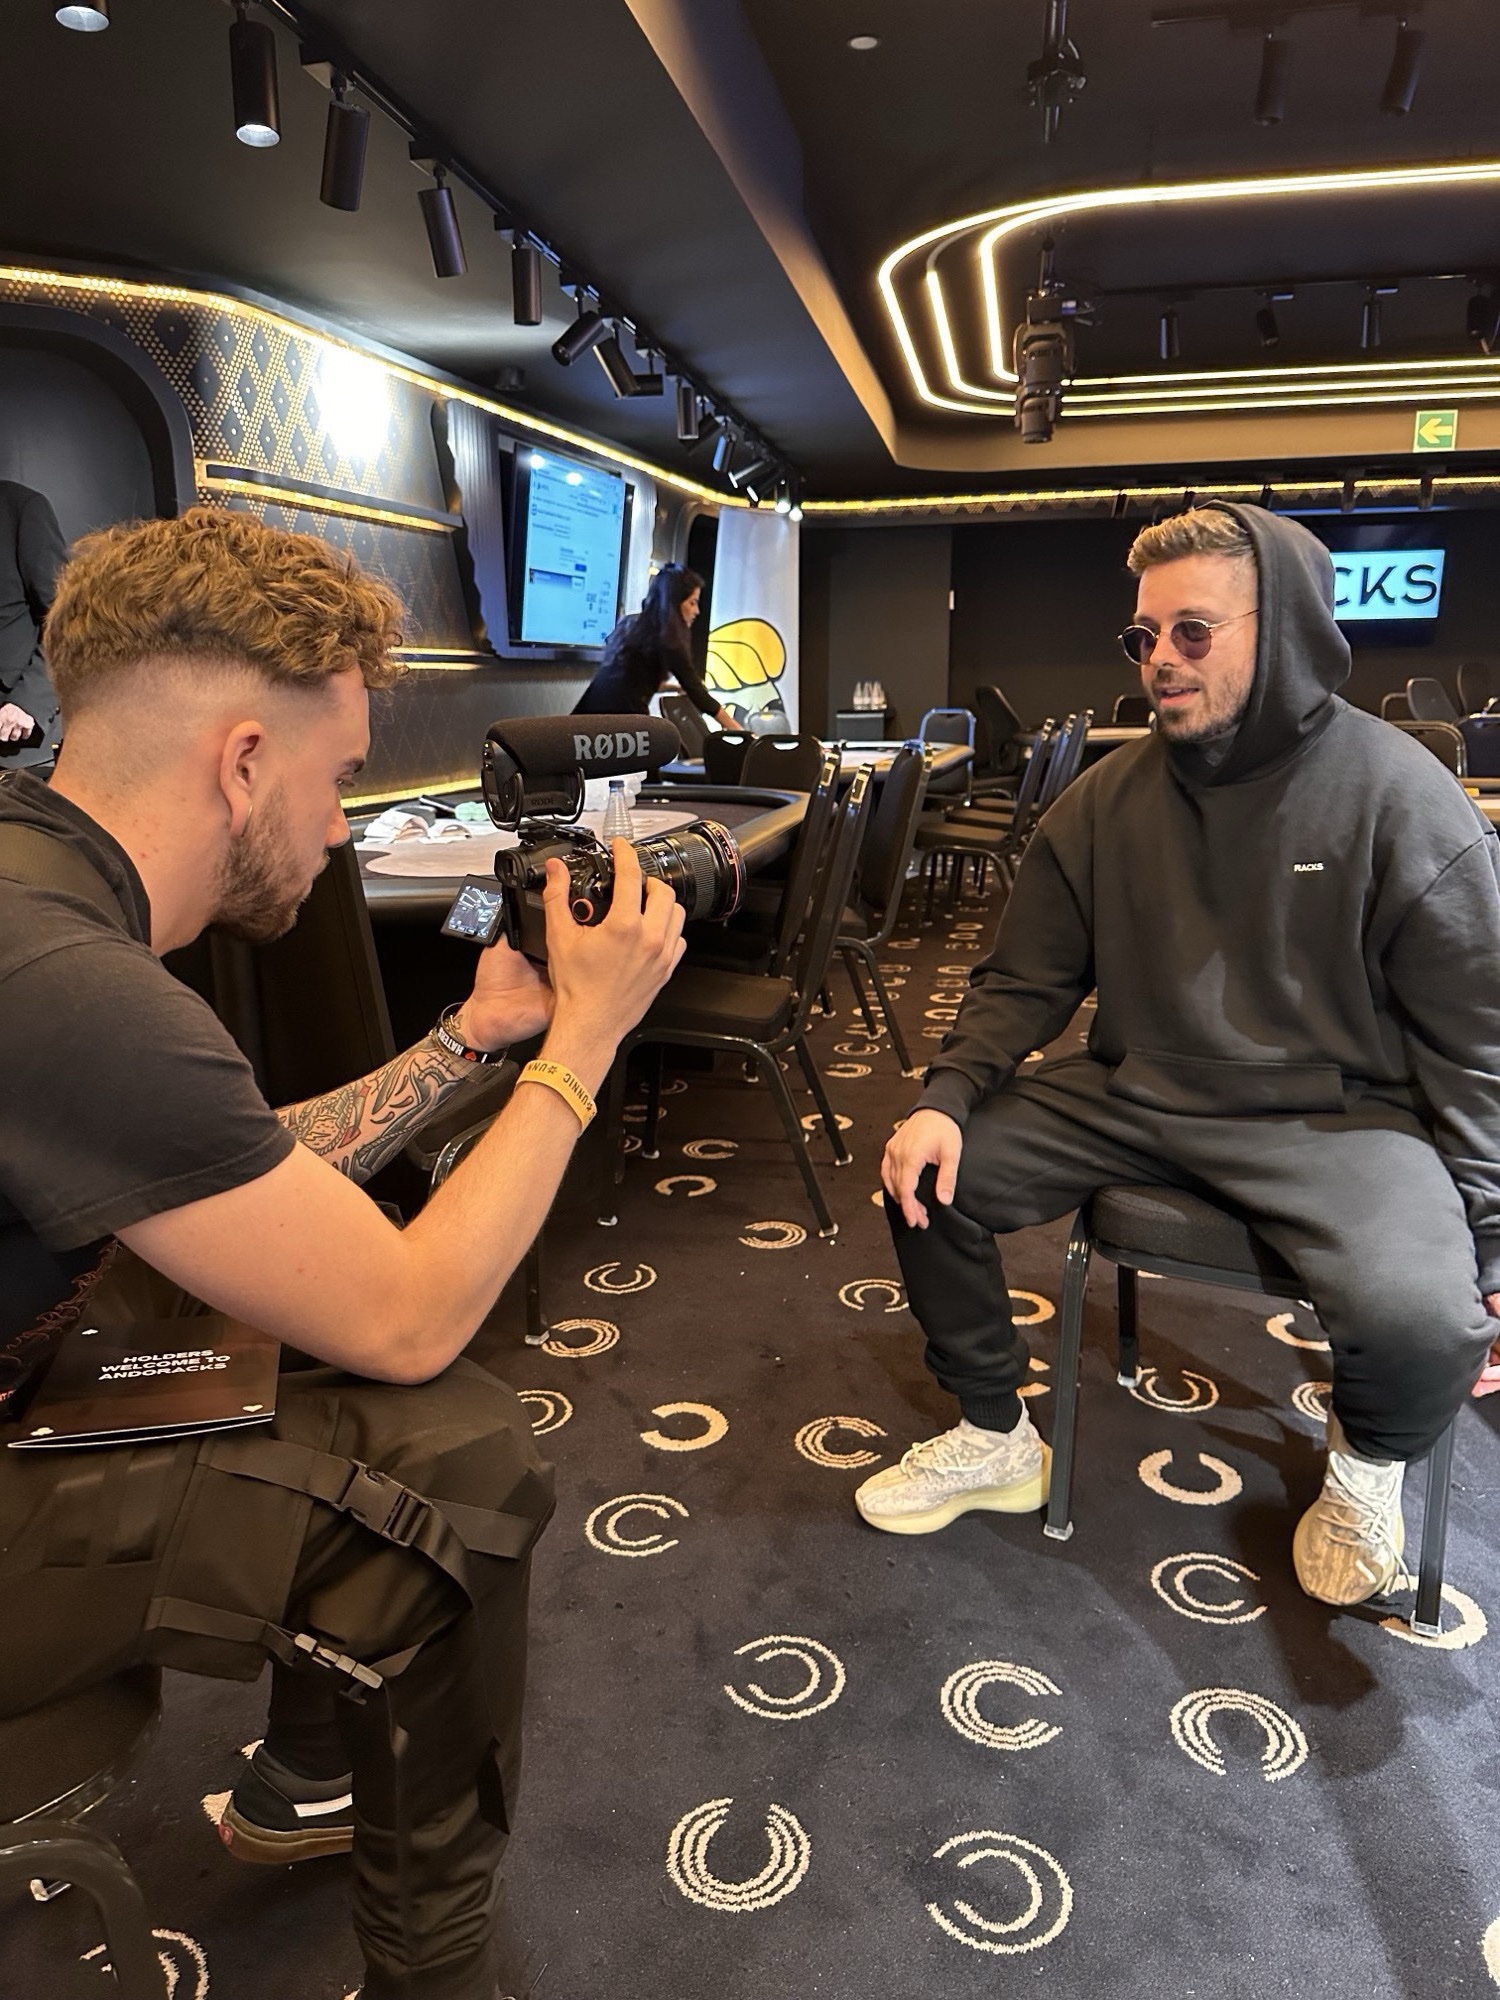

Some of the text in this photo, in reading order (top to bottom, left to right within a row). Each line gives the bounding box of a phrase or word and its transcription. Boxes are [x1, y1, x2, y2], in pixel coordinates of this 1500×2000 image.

[573, 731, 650, 760] RØDE
[1293, 862, 1324, 872] RACKS
[437, 1027, 464, 1056] HATERS
[101, 1354, 231, 1373] WELCOME TO
[123, 1349, 214, 1364] HOLDERS
[98, 1363, 227, 1380] ANDORACKS
